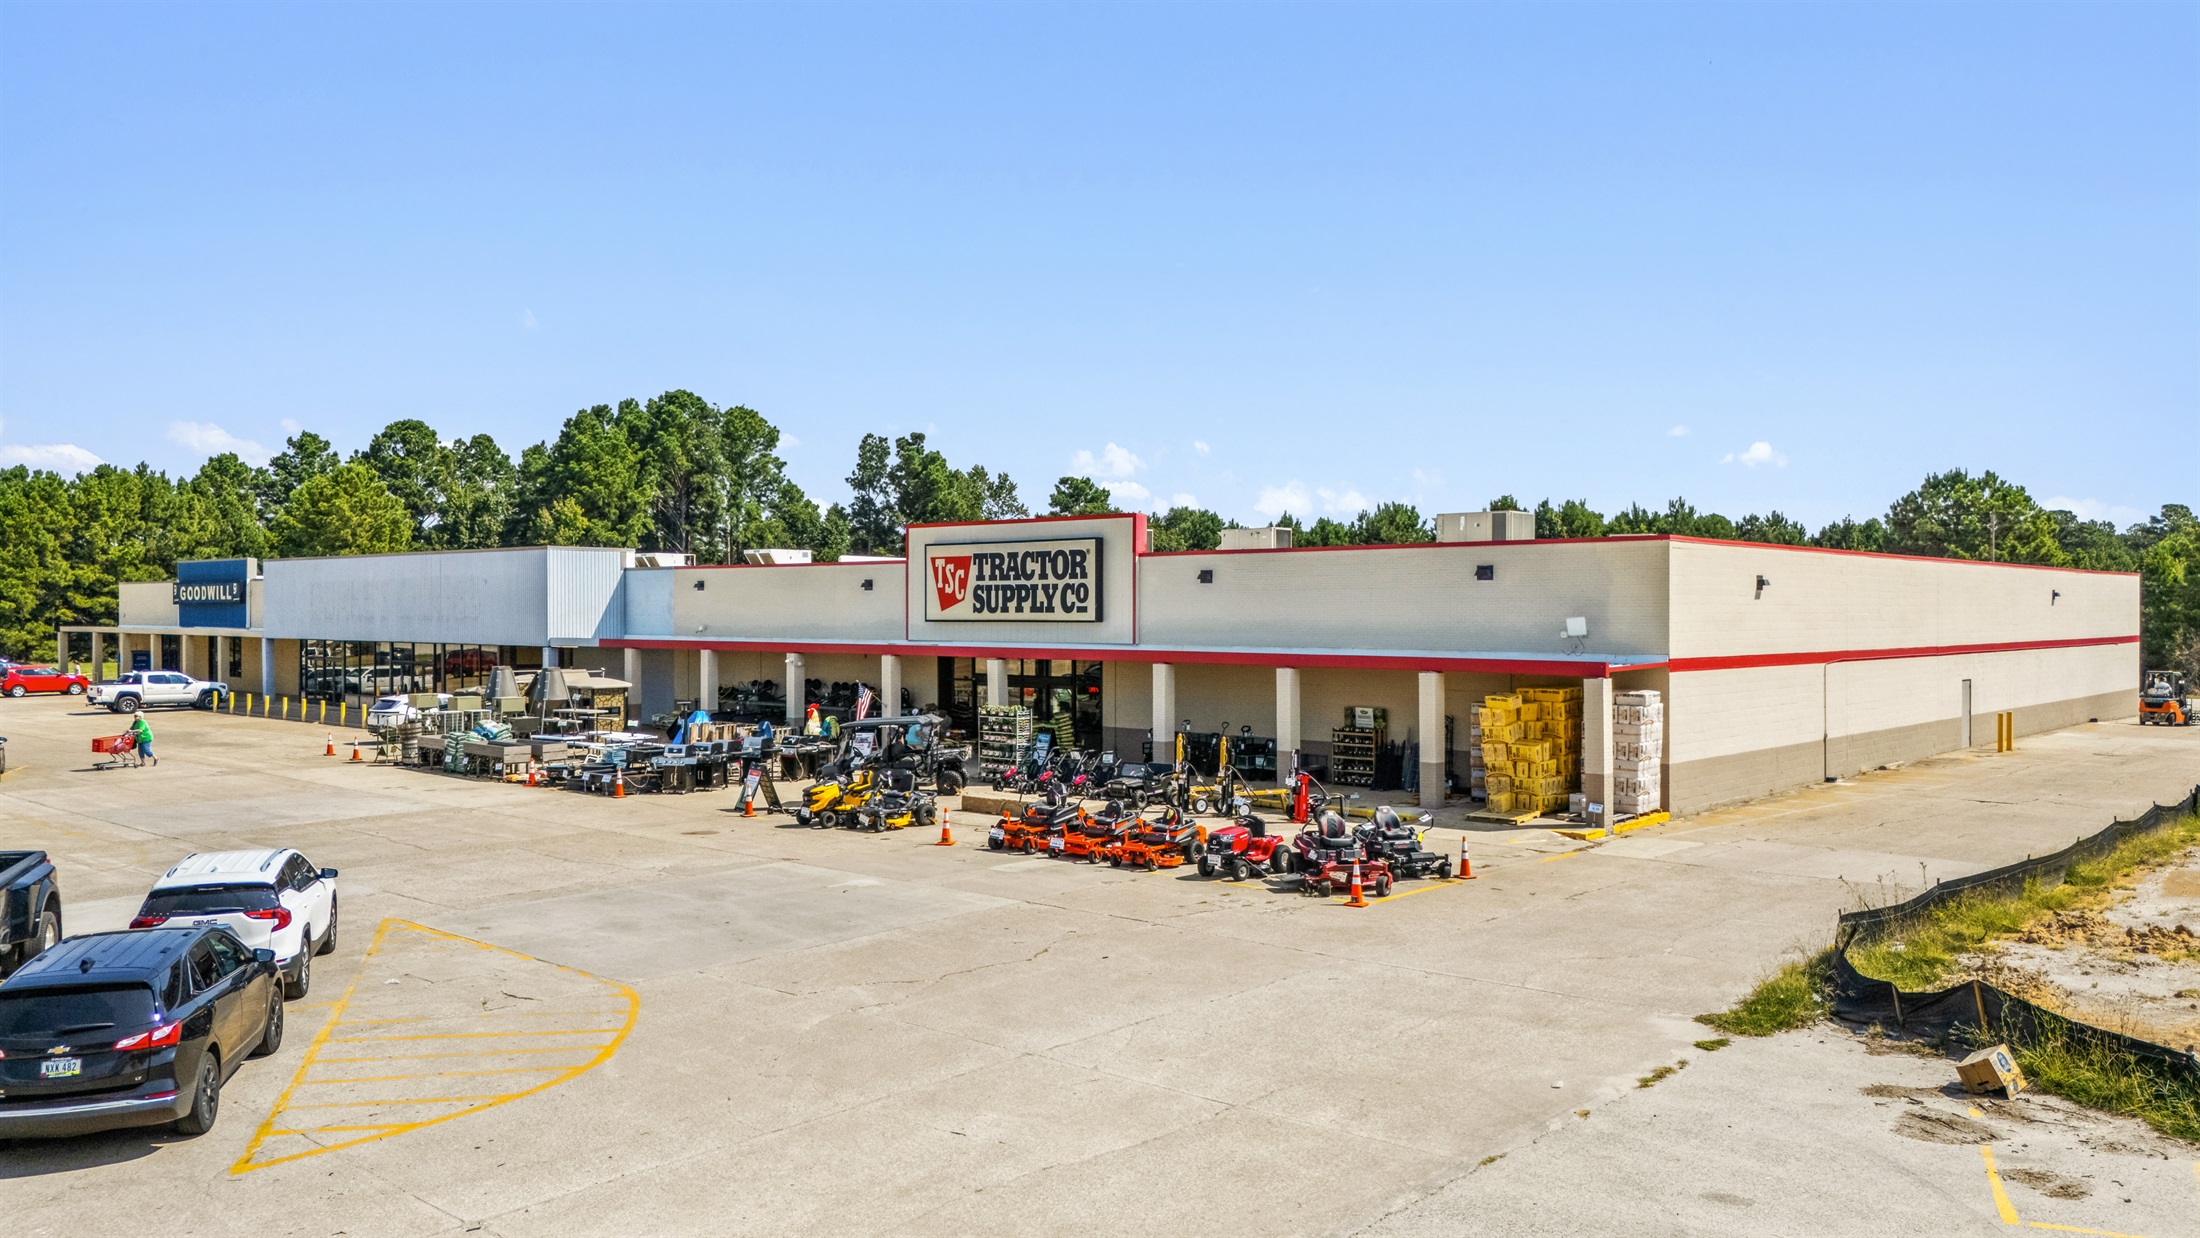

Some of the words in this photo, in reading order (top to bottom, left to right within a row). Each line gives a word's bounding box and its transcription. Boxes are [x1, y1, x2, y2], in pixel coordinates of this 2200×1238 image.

[973, 549, 1088, 582] TRACTOR
[935, 558, 965, 601] TSC
[179, 585, 232, 601] GOODWILL
[973, 584, 1058, 614] SUPPLY
[192, 918, 218, 926] GMC
[45, 1062, 60, 1073] NXK
[62, 1061, 77, 1072] 482
